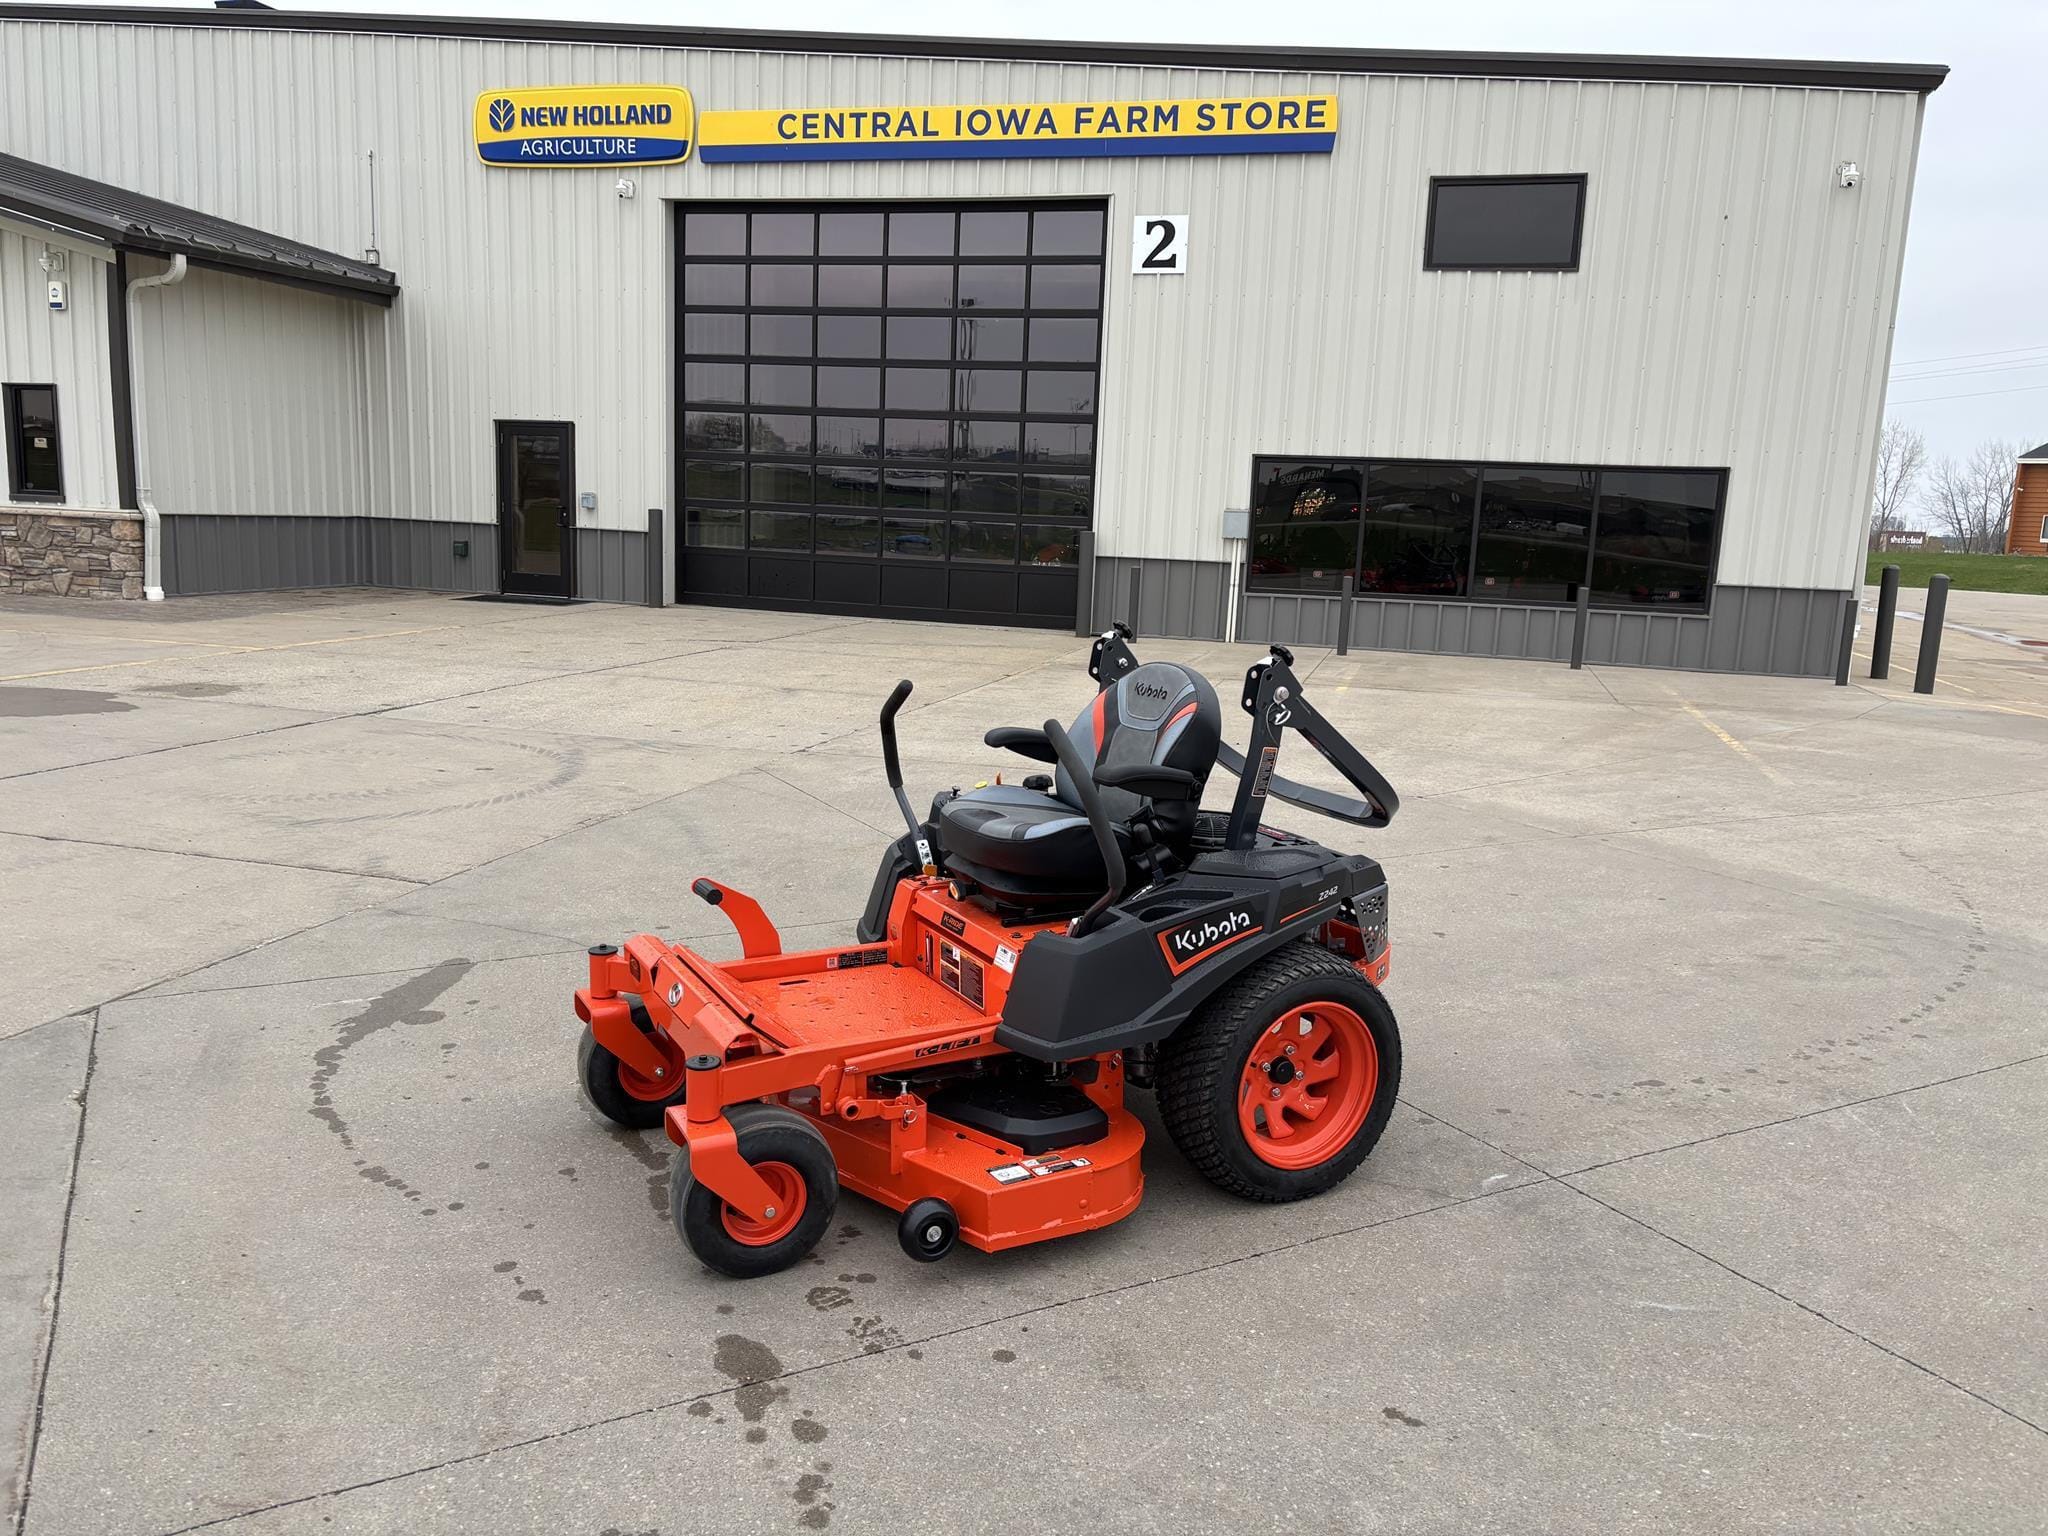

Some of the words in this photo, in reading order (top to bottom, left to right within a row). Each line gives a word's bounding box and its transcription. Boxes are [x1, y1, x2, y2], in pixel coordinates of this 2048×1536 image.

[521, 106, 568, 127] NEW
[573, 103, 672, 126] HOLLAND
[777, 110, 940, 139] CENTRAL
[955, 107, 1058, 136] IOWA
[1074, 104, 1180, 134] FARM
[1196, 99, 1327, 131] STORE
[520, 138, 637, 156] AGRICULTURE
[1142, 219, 1177, 268] 2
[1134, 682, 1168, 700] Kubota
[1318, 885, 1338, 902] Z242
[1175, 911, 1251, 951] Kubota
[917, 1035, 979, 1057] K-LIFT
